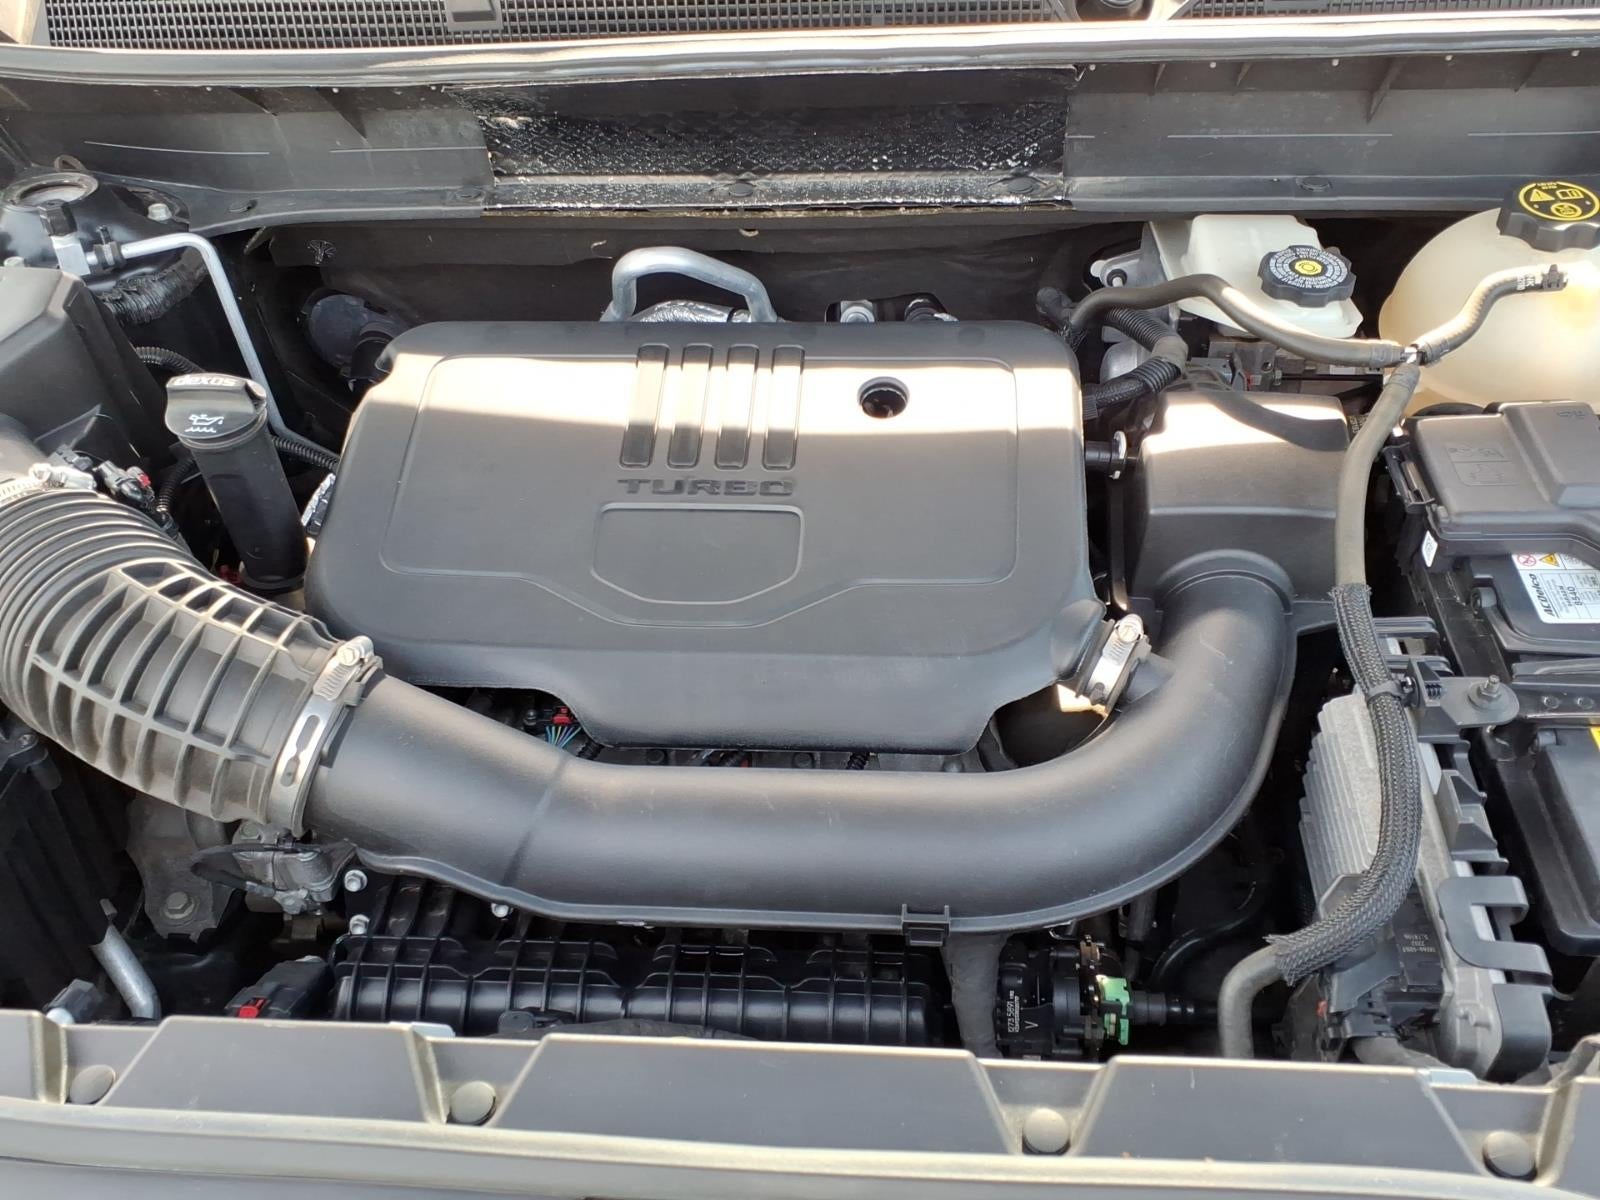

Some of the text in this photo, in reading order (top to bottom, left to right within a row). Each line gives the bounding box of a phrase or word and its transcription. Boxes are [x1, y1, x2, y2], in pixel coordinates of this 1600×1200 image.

[173, 375, 239, 387] dexos
[616, 479, 794, 496] TURBO
[1529, 573, 1555, 617] ACDelco
